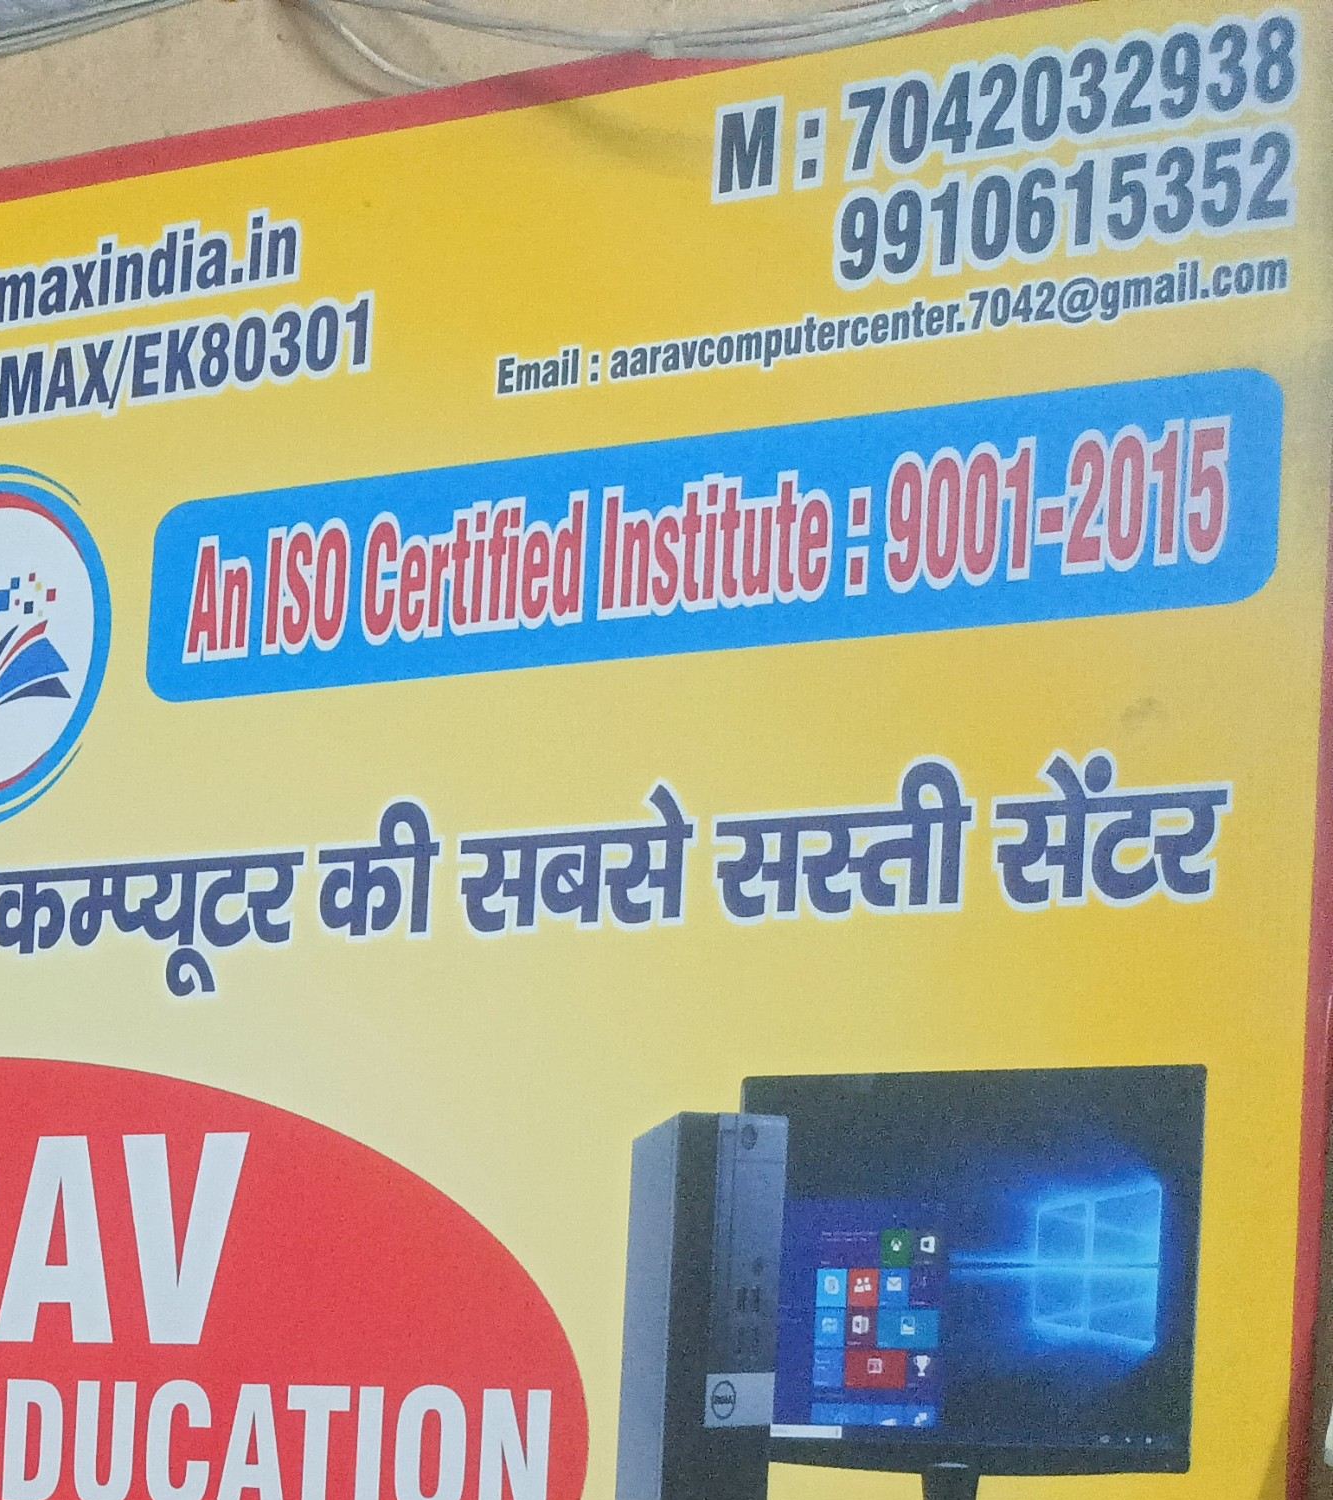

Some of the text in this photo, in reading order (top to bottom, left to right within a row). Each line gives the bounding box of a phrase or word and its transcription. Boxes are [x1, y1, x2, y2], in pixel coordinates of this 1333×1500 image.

[718, 107, 777, 194] M
[848, 15, 1298, 171] 7042032938
[838, 131, 1291, 282] 9910615352
[497, 349, 580, 396] Email
[608, 256, 1290, 381] aaravcomputercenter.7042@gmail.com
[187, 543, 248, 655] An
[265, 527, 348, 649] ISO
[363, 498, 583, 639] Certified
[602, 478, 829, 611] Institute
[889, 424, 1228, 584] 9001-2015
[318, 800, 440, 937] की
[460, 784, 694, 933] सबसे
[716, 761, 973, 919] सस्ती
[994, 755, 1229, 905] सेंटर
